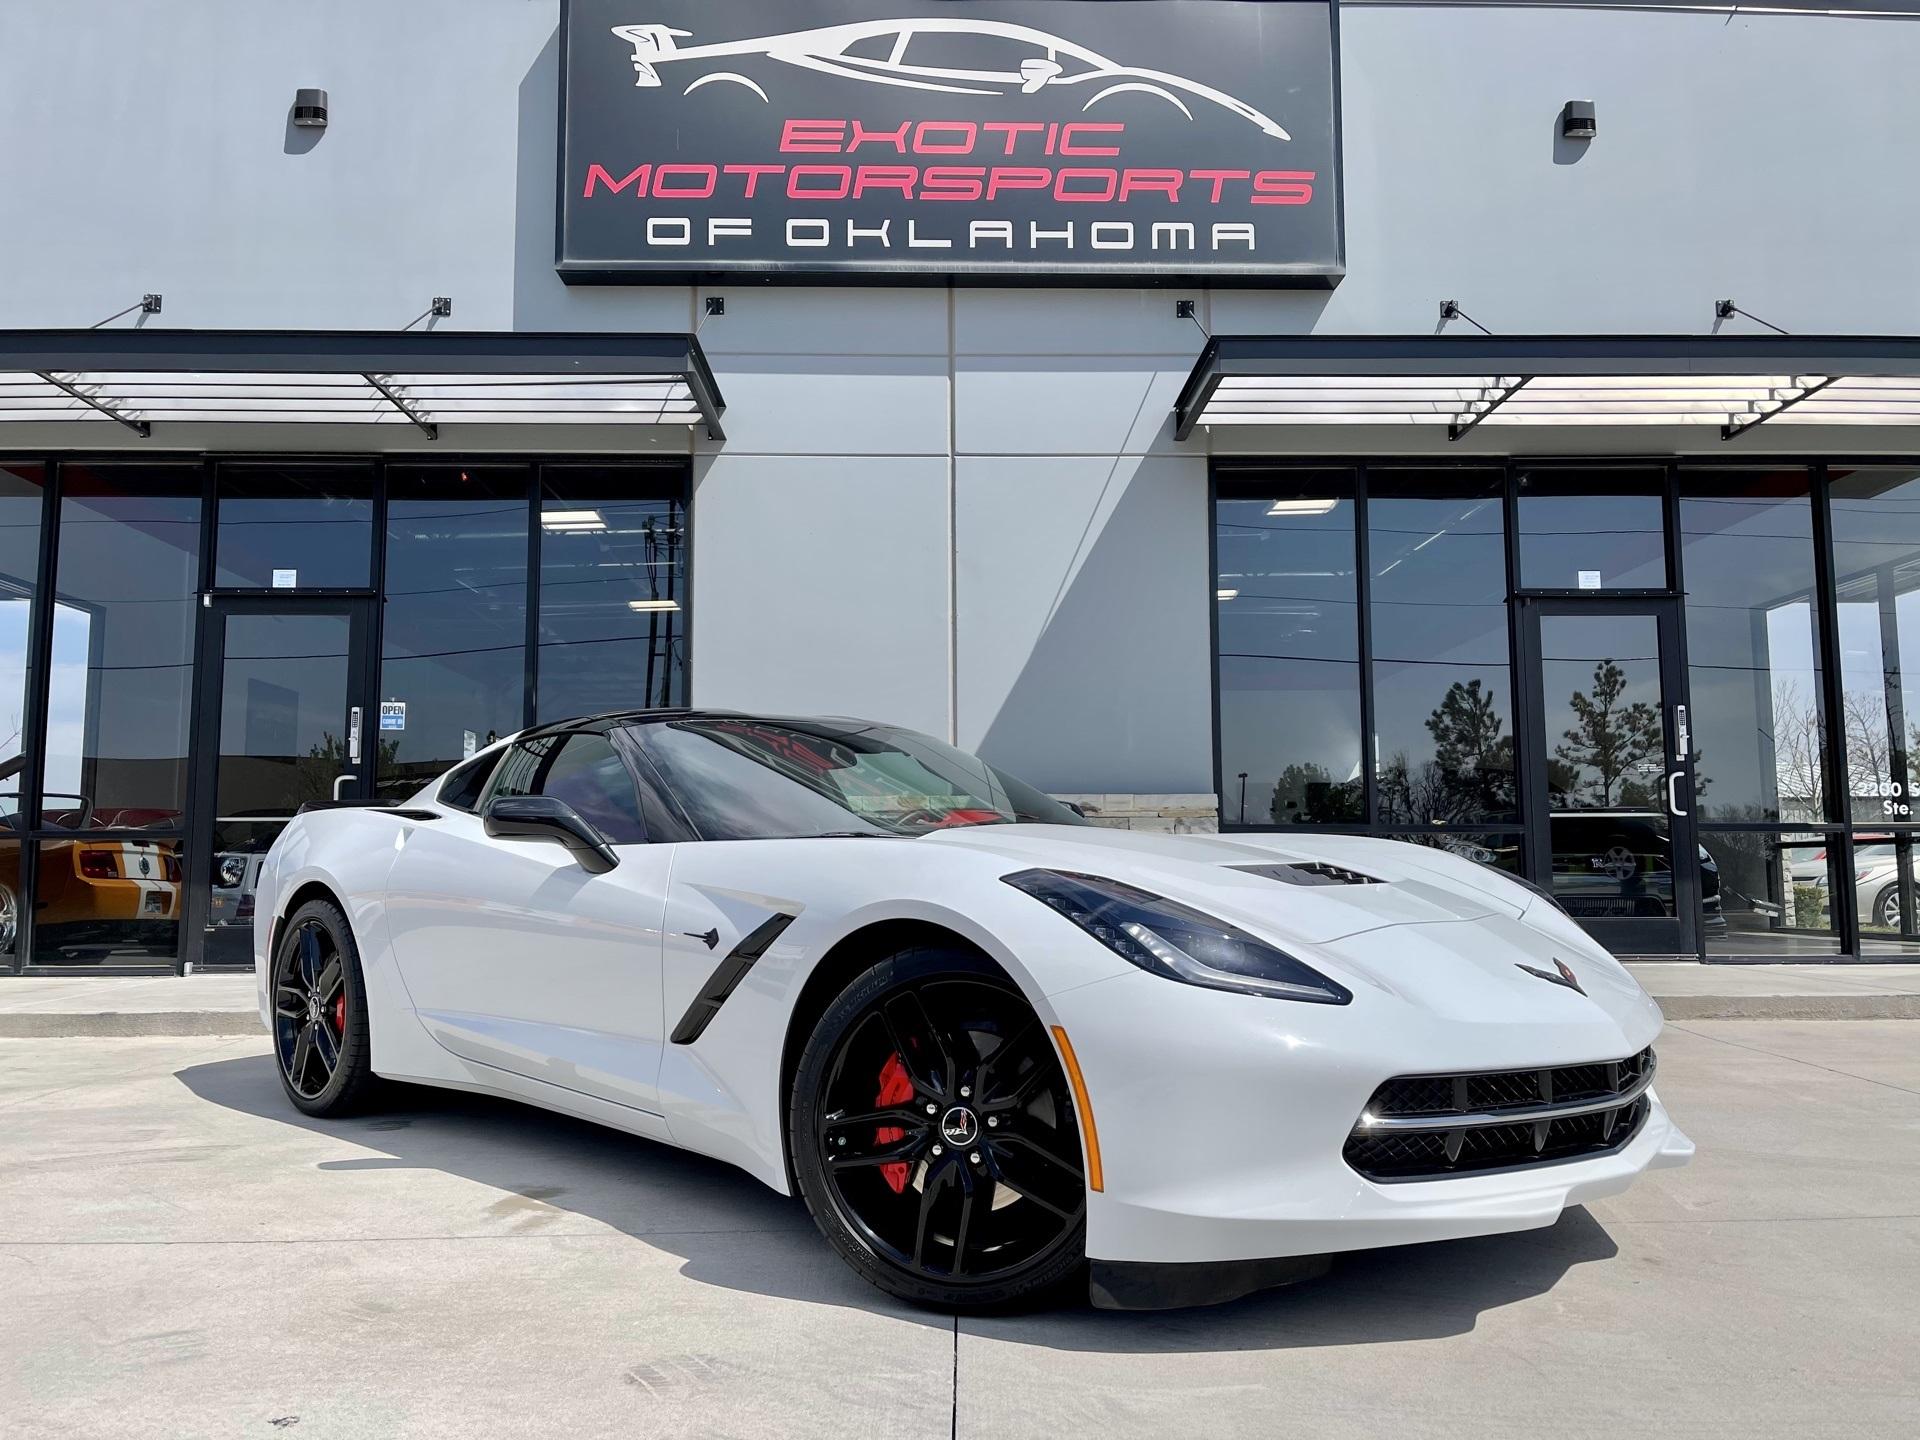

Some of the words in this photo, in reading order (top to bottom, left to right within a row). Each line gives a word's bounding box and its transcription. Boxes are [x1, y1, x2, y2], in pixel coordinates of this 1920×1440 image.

[779, 118, 1125, 157] EXOTIC
[583, 163, 1316, 206] MOTORSPORTS
[646, 217, 752, 246] OF
[785, 218, 1256, 250] OKLAHOMA
[382, 705, 404, 715] OPEN
[1883, 799, 1914, 815] Ste.
